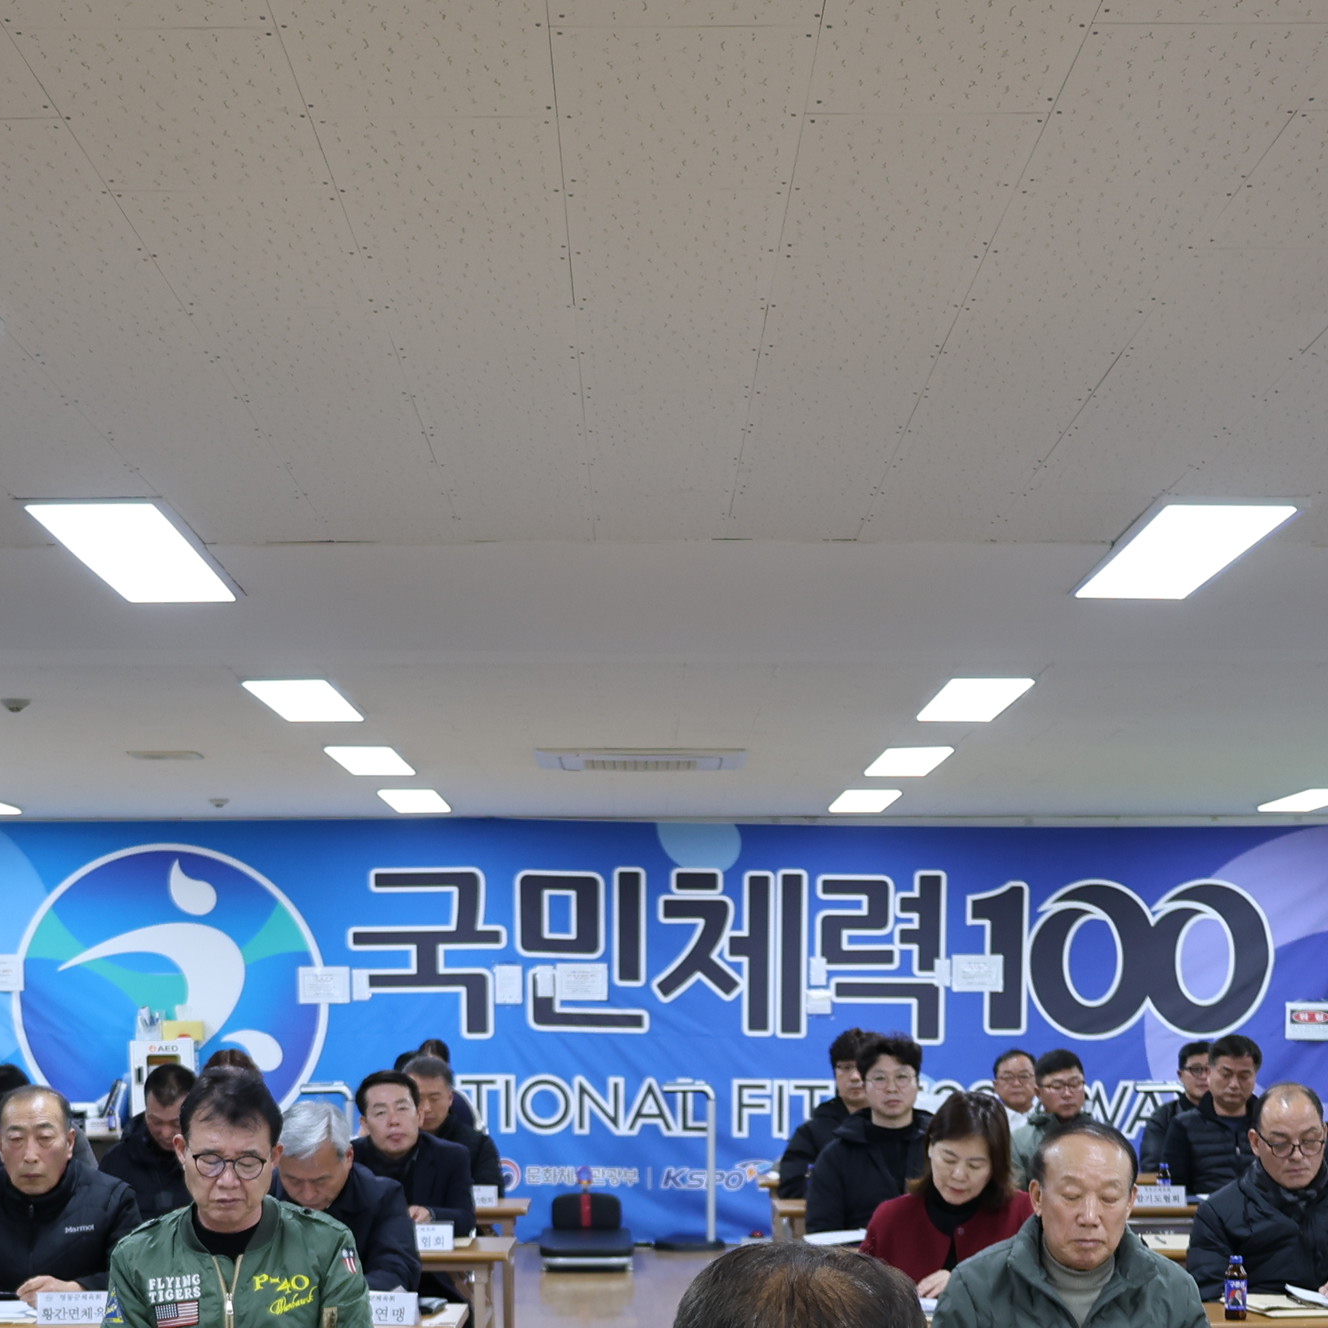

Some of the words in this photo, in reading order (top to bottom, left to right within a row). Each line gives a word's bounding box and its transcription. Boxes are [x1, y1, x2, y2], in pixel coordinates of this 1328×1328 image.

[456, 1073, 709, 1137] TIONAL
[525, 1165, 639, 1187] 문화체관광부
[64, 1224, 95, 1234] Marmot
[148, 1273, 201, 1291] FLYING
[252, 1273, 310, 1294] P-40
[148, 1286, 201, 1304] TIGERS
[42, 1306, 105, 1321] 황간면체육
